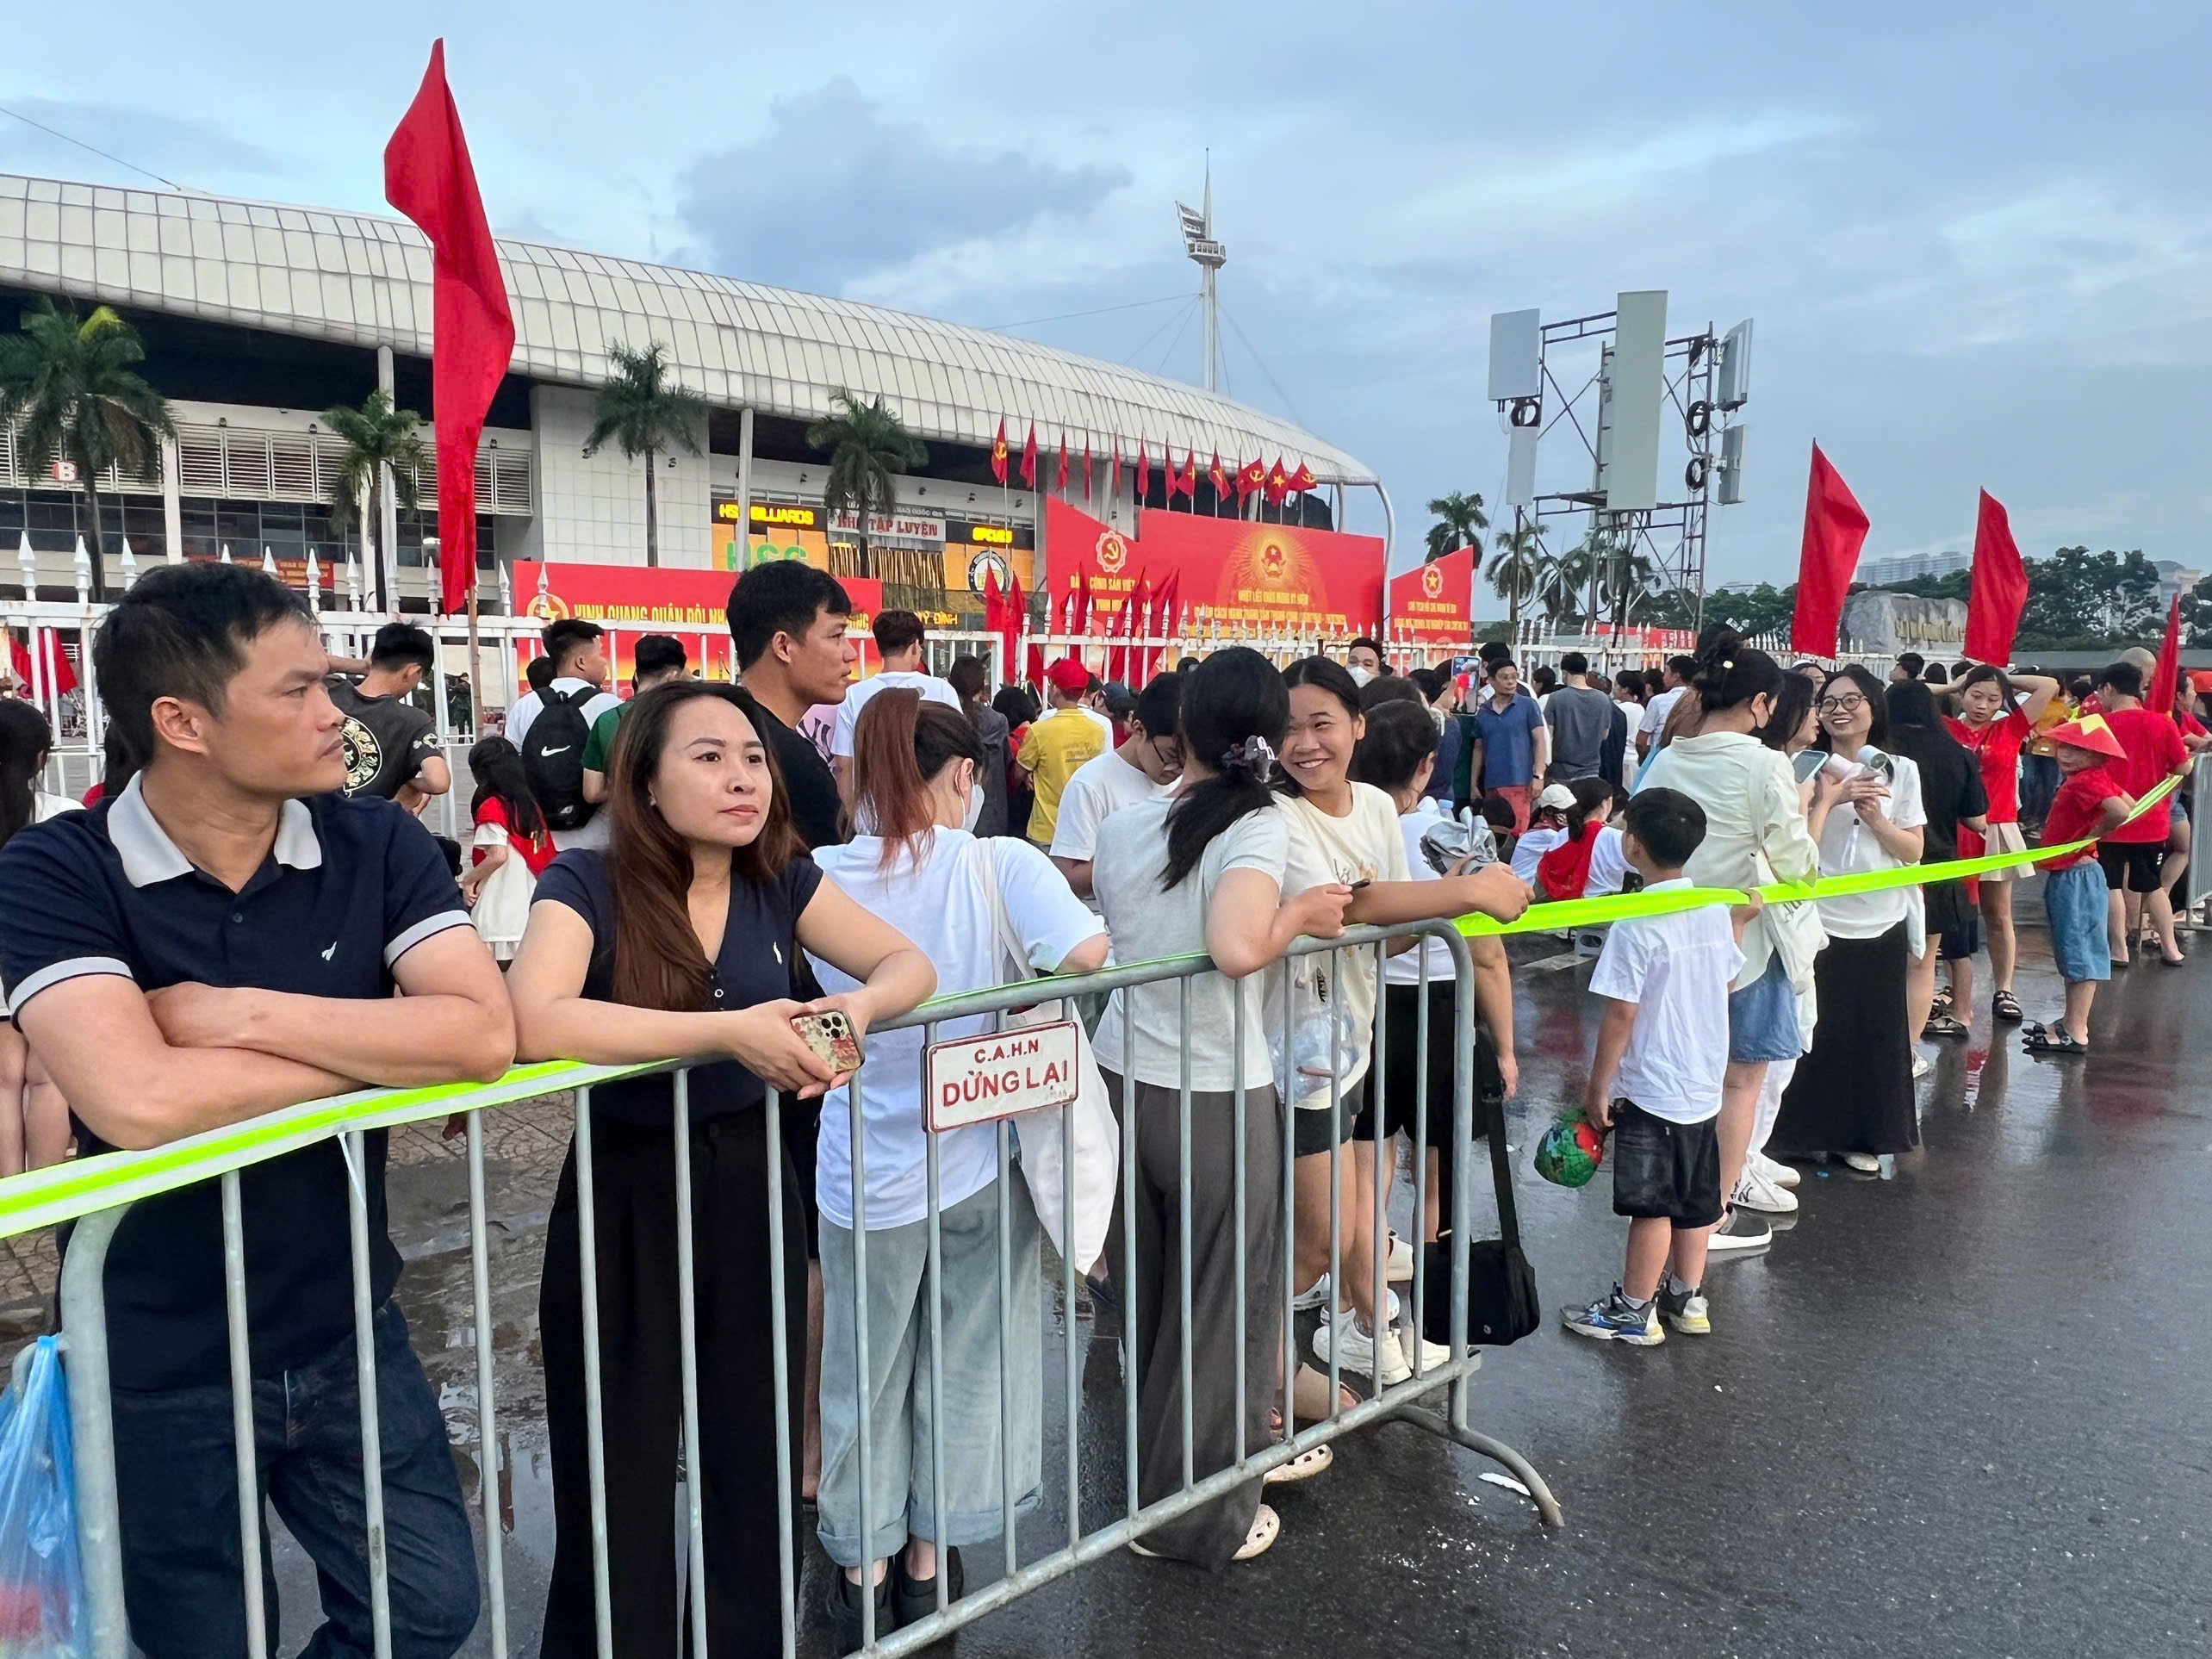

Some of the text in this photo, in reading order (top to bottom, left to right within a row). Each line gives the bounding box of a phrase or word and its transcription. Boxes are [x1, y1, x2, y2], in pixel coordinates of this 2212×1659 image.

[58, 462, 77, 482] B
[719, 503, 739, 519] HS
[897, 520, 938, 537] LUYỆN
[974, 1038, 1039, 1064] C.A.H.N
[942, 1070, 1020, 1108] DỪNG
[1026, 1059, 1068, 1090] LẠI
